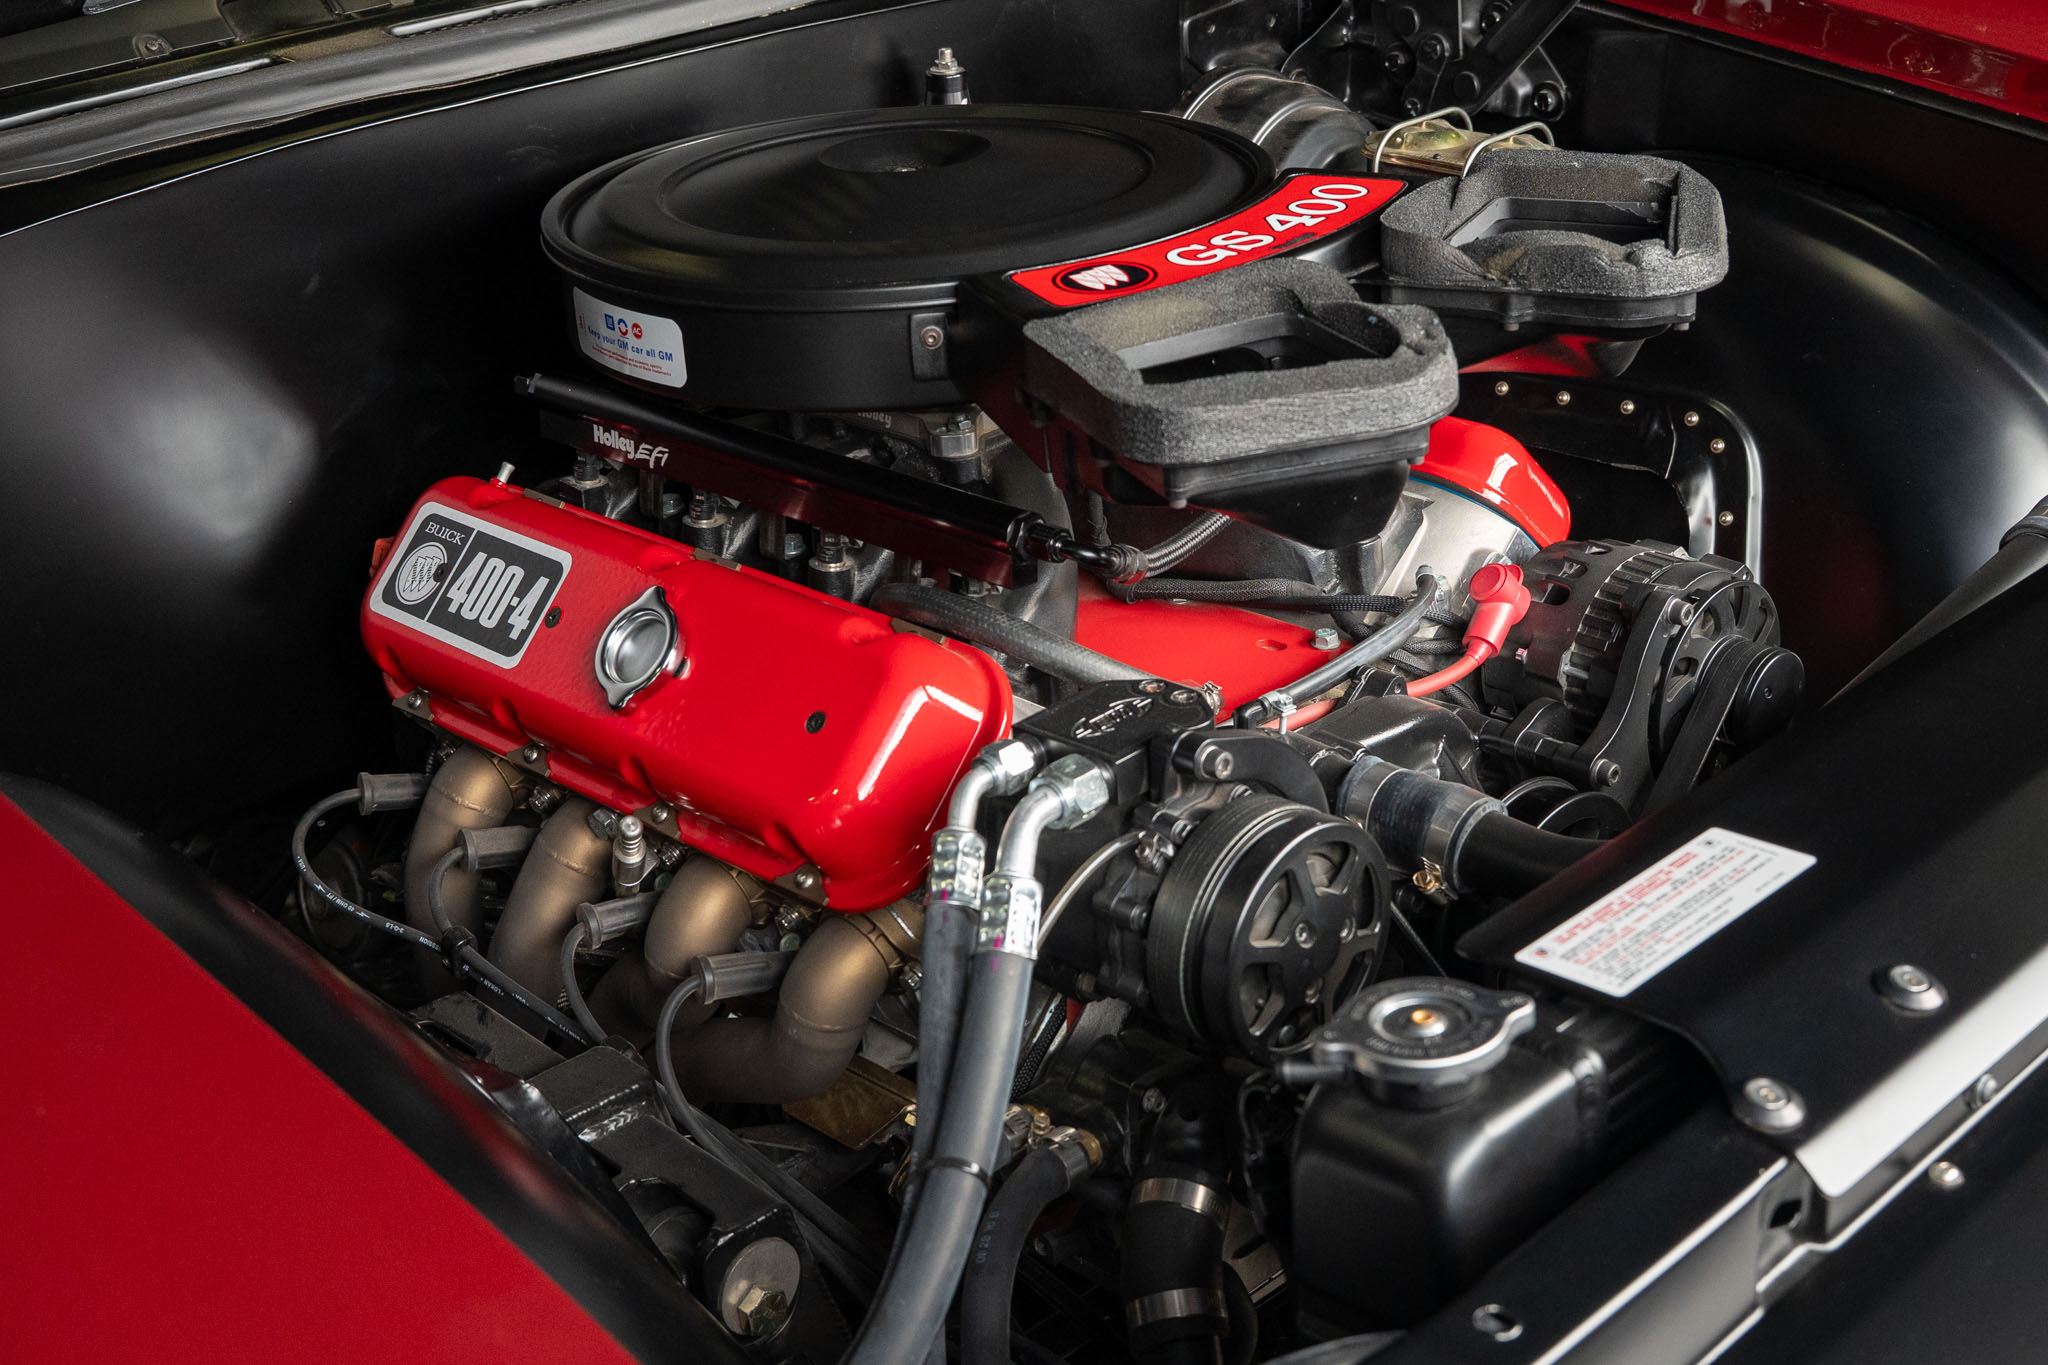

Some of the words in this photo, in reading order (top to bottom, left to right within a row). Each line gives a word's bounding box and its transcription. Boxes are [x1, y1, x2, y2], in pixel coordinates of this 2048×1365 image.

[1166, 229, 1275, 267] GS
[1265, 183, 1369, 232] 400
[602, 335, 616, 346] your
[617, 338, 629, 351] GM
[631, 345, 643, 355] car
[646, 347, 656, 358] all
[658, 350, 674, 362] GM
[593, 423, 635, 460] Holley
[425, 521, 466, 546] BUICK
[446, 551, 551, 641] 400-4
